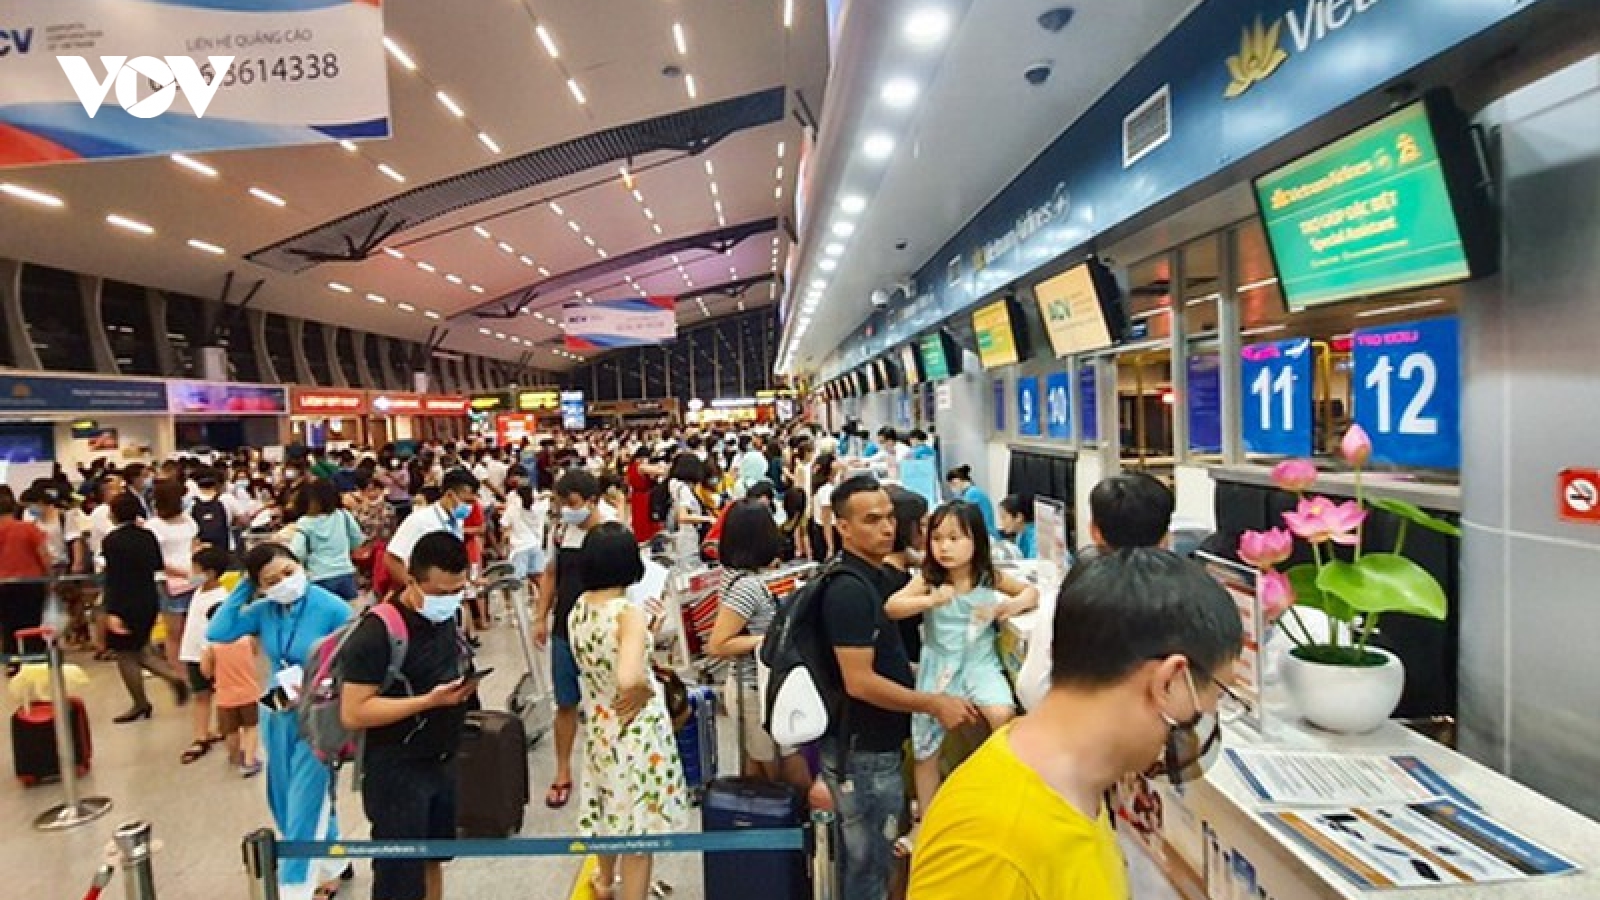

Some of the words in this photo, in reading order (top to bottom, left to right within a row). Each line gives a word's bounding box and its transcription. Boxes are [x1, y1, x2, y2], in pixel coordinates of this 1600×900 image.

[1021, 389, 1032, 423] 9
[1251, 365, 1299, 431] 11
[1365, 352, 1438, 435] 12
